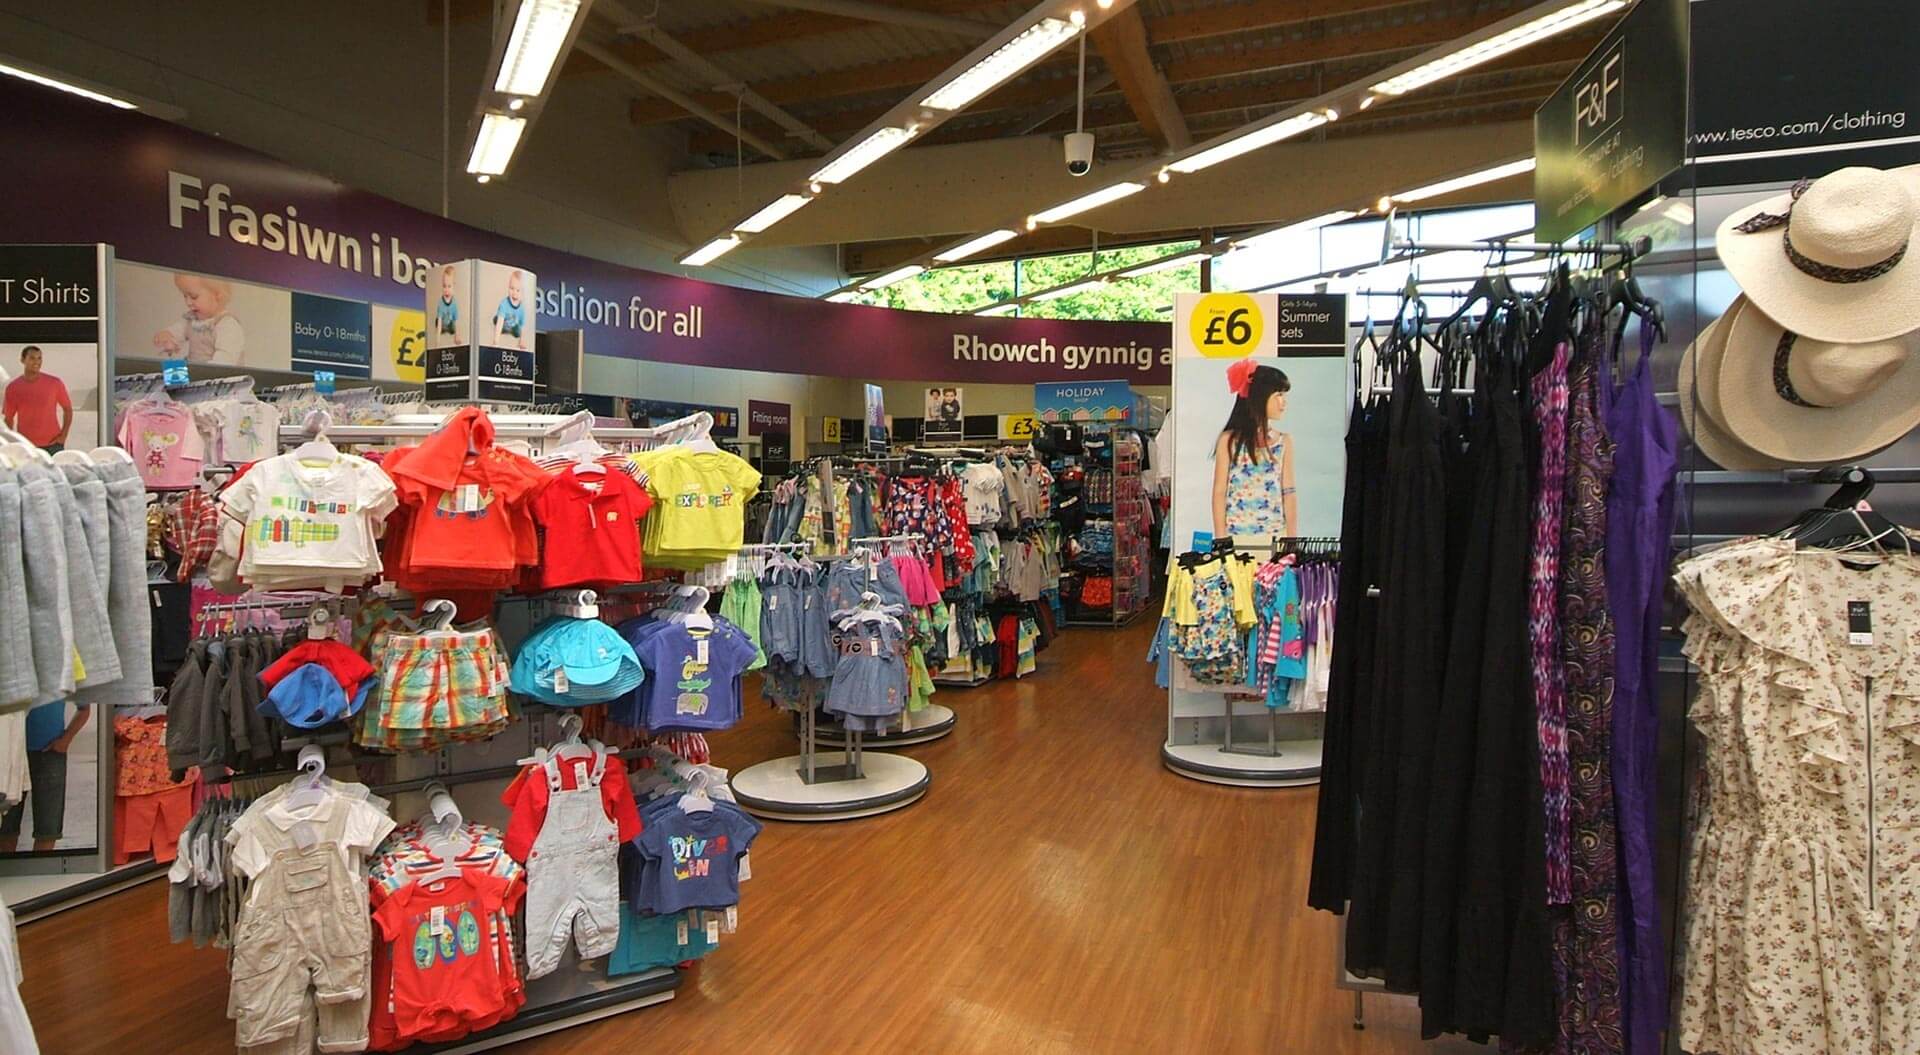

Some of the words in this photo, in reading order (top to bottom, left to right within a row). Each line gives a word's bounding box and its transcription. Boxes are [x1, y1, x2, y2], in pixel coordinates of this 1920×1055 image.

[1575, 52, 1621, 146] F&F
[168, 170, 362, 272] Ffasiwn
[371, 232, 382, 278] i
[391, 237, 442, 289] ba
[0, 279, 15, 304] T
[22, 277, 90, 304] Shirts
[535, 281, 620, 327] ashion
[628, 296, 667, 333] for
[673, 305, 702, 338] all
[1280, 309, 1331, 324] Summer
[294, 321, 322, 340] Baby
[1204, 308, 1252, 346] £6
[1280, 327, 1304, 339] sets
[501, 351, 518, 365] Baby
[953, 334, 1056, 364] Rhowch
[1062, 341, 1153, 371] gynnig
[1055, 387, 1105, 398] HOLIDAY
[752, 410, 772, 427] Fitting
[772, 414, 788, 425] room
[1012, 417, 1033, 436] £3
